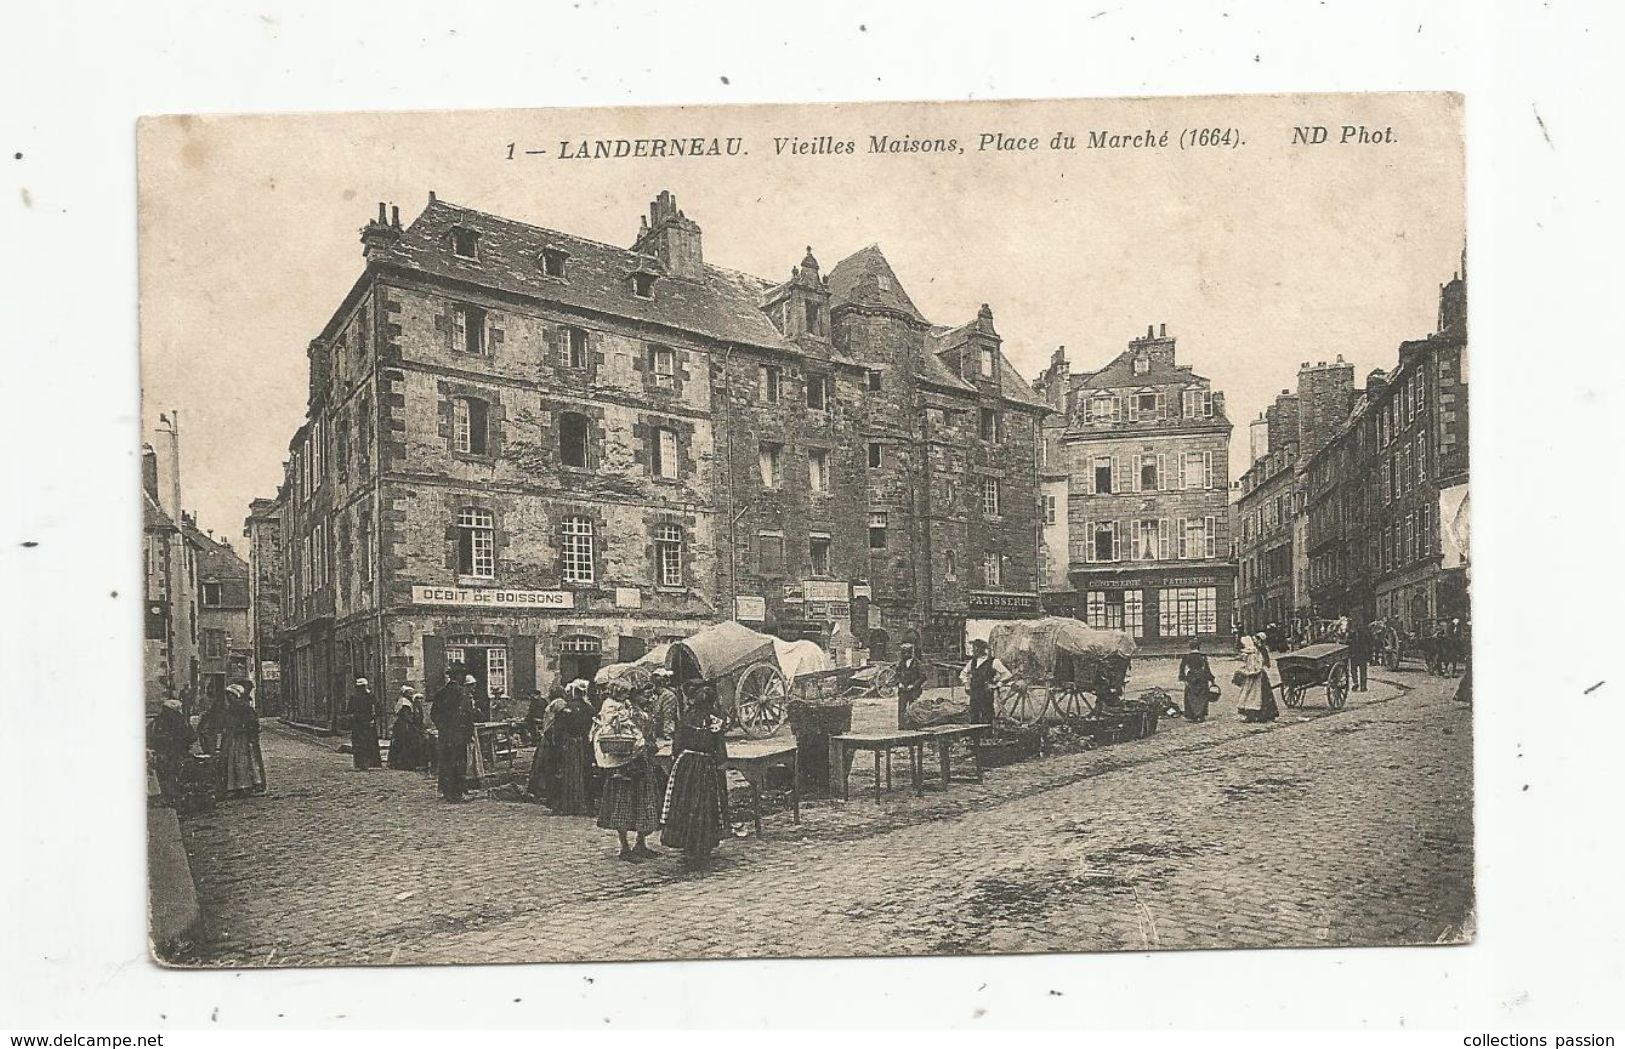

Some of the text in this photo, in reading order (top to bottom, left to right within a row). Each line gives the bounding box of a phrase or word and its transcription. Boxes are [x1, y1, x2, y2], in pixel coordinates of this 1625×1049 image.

[1292, 125, 1398, 144] ND Phot.
[506, 142, 516, 160] 1
[558, 137, 748, 160] LANDERNEAU.
[773, 136, 855, 155] Vieilles
[868, 134, 964, 155] Maisons,
[978, 132, 1039, 151] Place
[1050, 131, 1075, 150] du
[1087, 128, 1168, 149] Marché
[1180, 126, 1246, 150] (1664).
[496, 592, 563, 604] BOISSONS
[969, 595, 1032, 607] PATISSERIE
